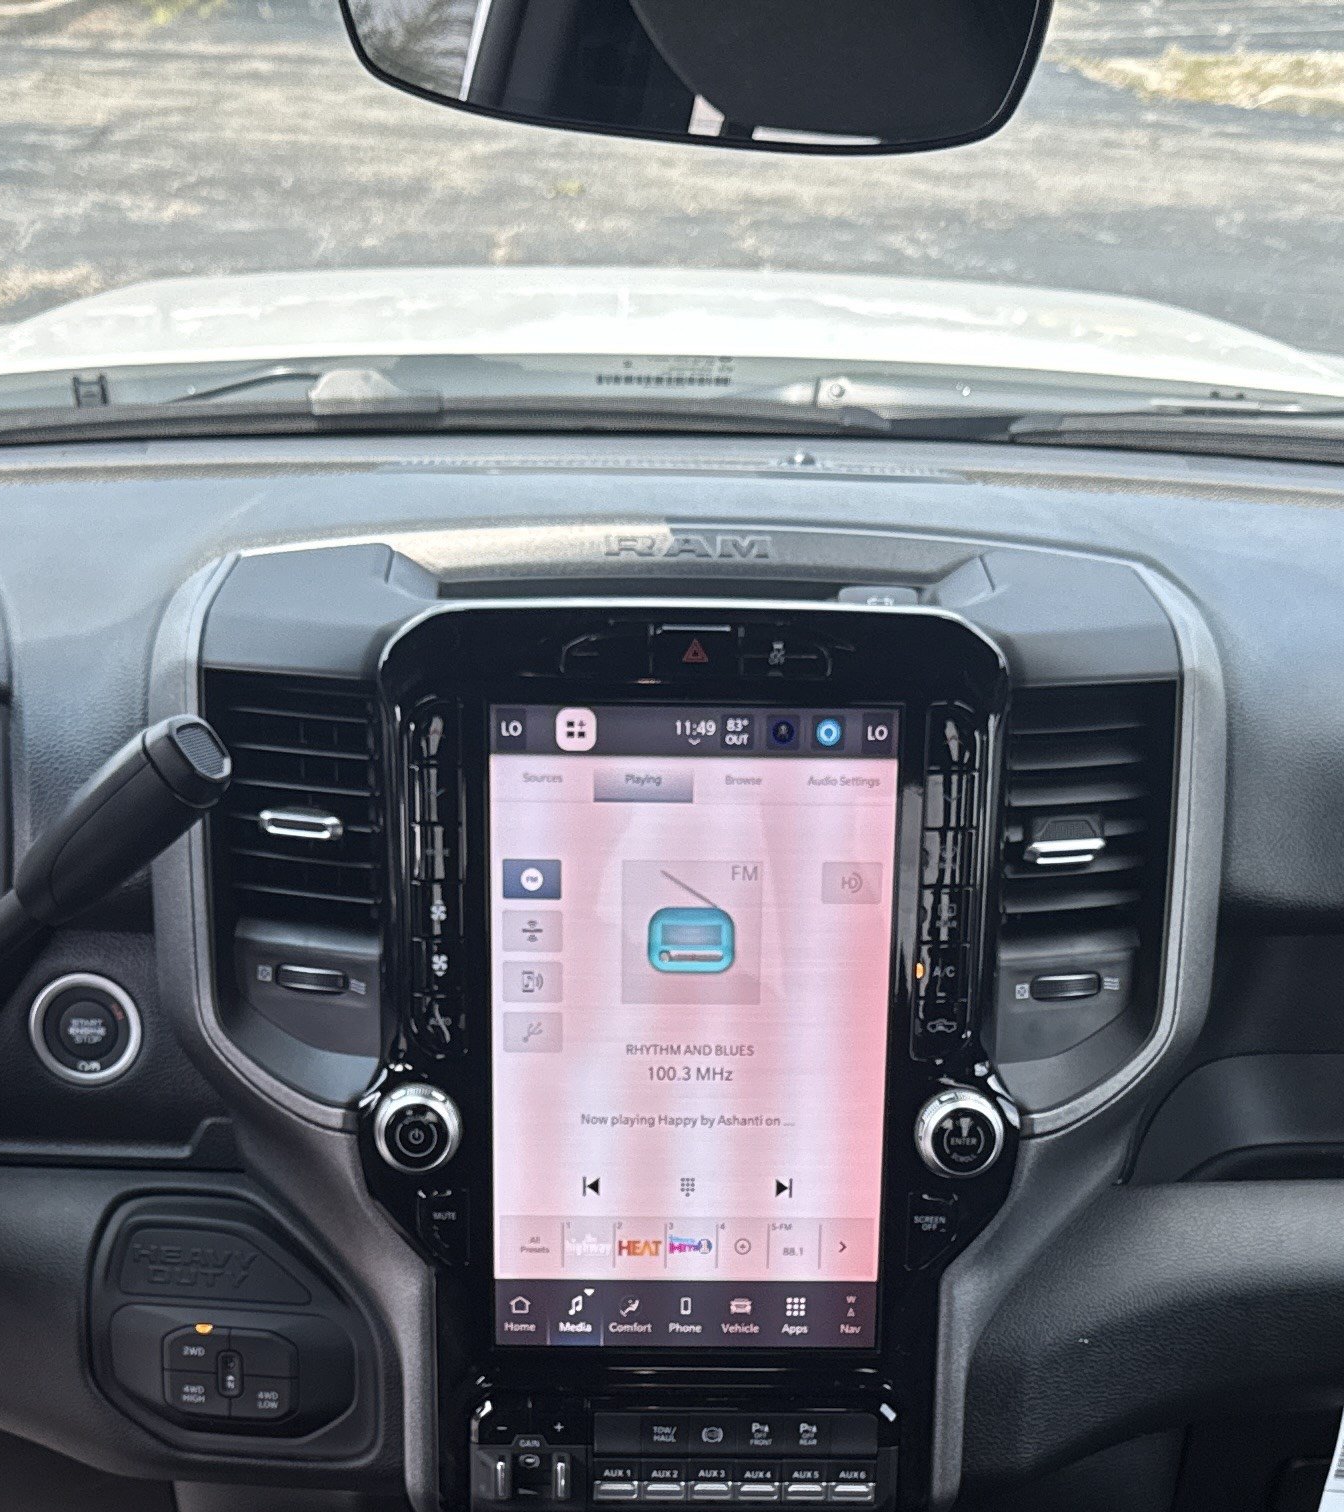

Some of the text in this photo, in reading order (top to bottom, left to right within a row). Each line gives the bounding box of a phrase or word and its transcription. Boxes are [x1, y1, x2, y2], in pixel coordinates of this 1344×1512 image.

[604, 533, 773, 559] RAM
[501, 720, 523, 737] LO
[675, 719, 717, 736] 11:49
[867, 724, 889, 741] LO
[725, 733, 749, 746] OUT
[522, 772, 563, 784] Sources
[624, 774, 662, 787] Playing
[725, 775, 762, 786] Browse
[808, 775, 881, 788] Audio Settings
[731, 866, 759, 882] FM
[625, 1043, 755, 1057] RHYTHM AND BLUES
[648, 1066, 734, 1082] 100.3 MHz
[581, 1113, 781, 1129] Now playing Happy by Ashanti on
[432, 1211, 456, 1221] MUTE
[618, 1239, 662, 1257] HEAT
[782, 1247, 804, 1257] 88.1
[133, 1243, 258, 1269] HEAVY
[147, 1265, 250, 1289] DUTY
[504, 1322, 536, 1332] Home
[559, 1321, 593, 1332] Media
[608, 1322, 652, 1333] Comfort
[668, 1322, 703, 1333] Phone
[721, 1323, 760, 1334] Vehicle
[781, 1323, 809, 1336] Apps
[839, 1323, 862, 1334] Nav
[182, 1345, 206, 1357] 2WD
[183, 1384, 205, 1394] 4WD
[257, 1391, 279, 1400] 4WD
[603, 1469, 623, 1477] AUX
[651, 1470, 670, 1478] AUX
[698, 1469, 718, 1478] AUX
[744, 1470, 764, 1479] AUX
[792, 1471, 812, 1479] AUX
[839, 1471, 859, 1479] AUX
